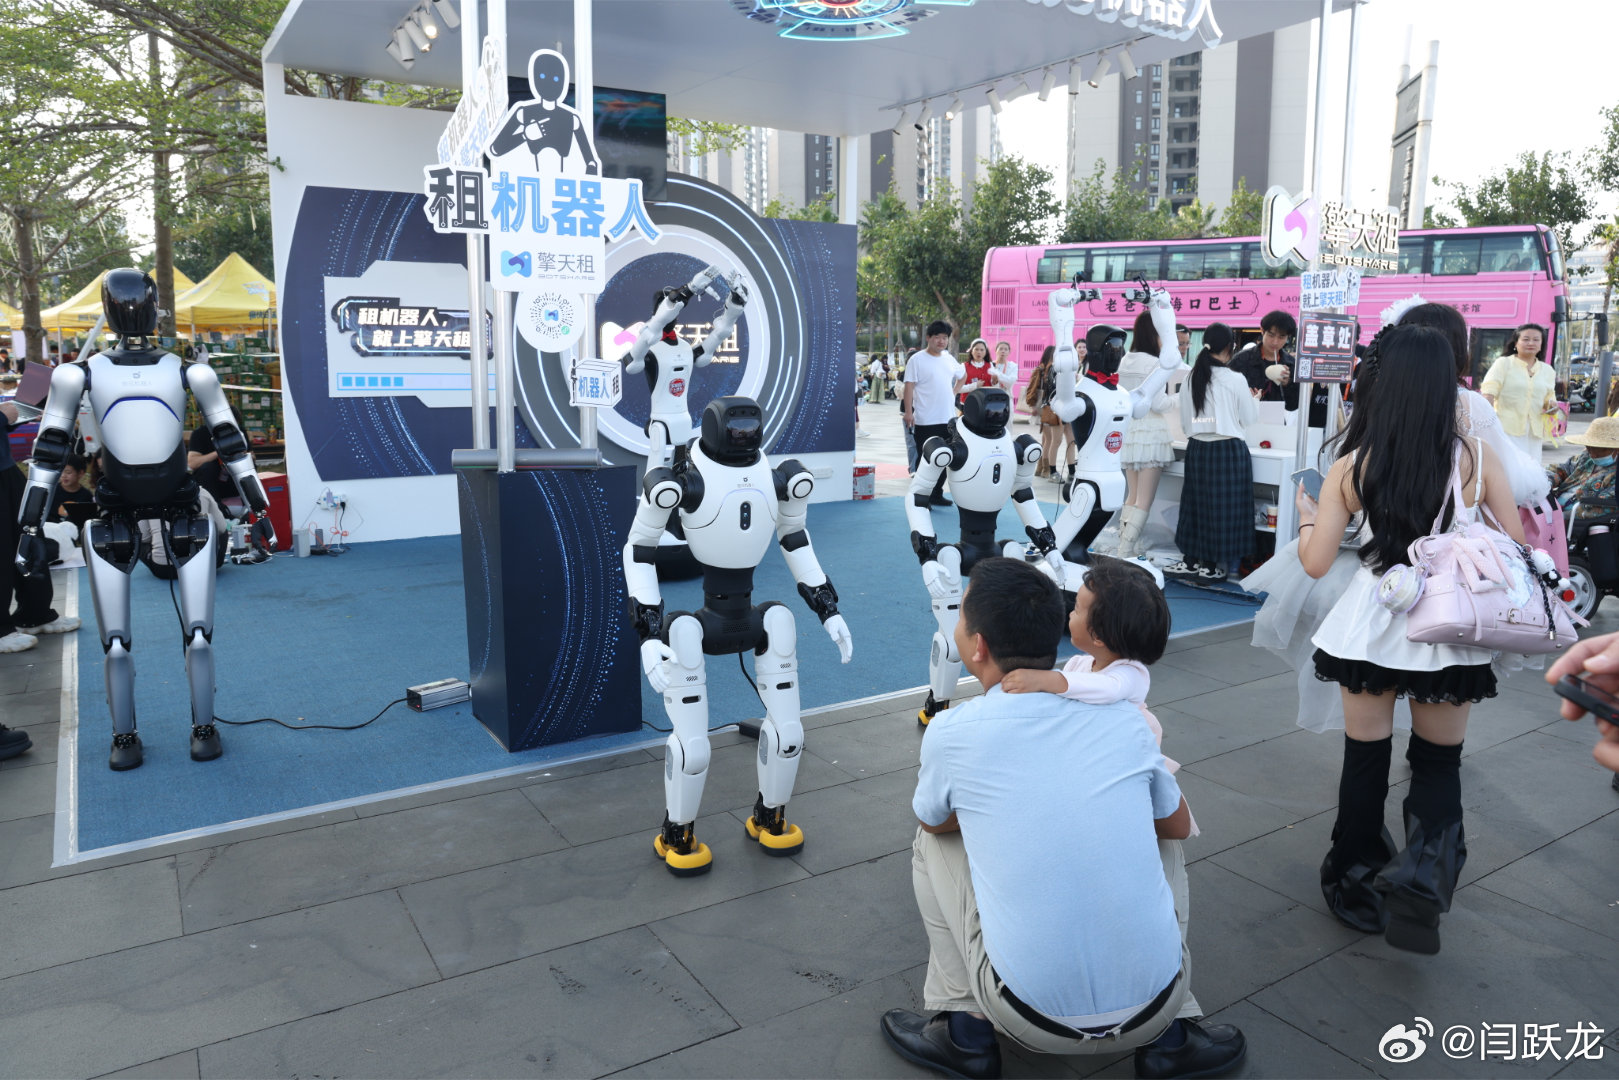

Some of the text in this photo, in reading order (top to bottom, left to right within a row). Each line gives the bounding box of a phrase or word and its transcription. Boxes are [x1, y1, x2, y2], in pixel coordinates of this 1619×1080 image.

[429, 166, 660, 241] 租机器人
[1321, 201, 1399, 255] 擎天租
[537, 252, 595, 274] 擎天租
[1302, 271, 1339, 290] 租机器人
[1304, 323, 1352, 350] 盖章处
[578, 373, 611, 400] 机器人
[612, 374, 621, 397] 租
